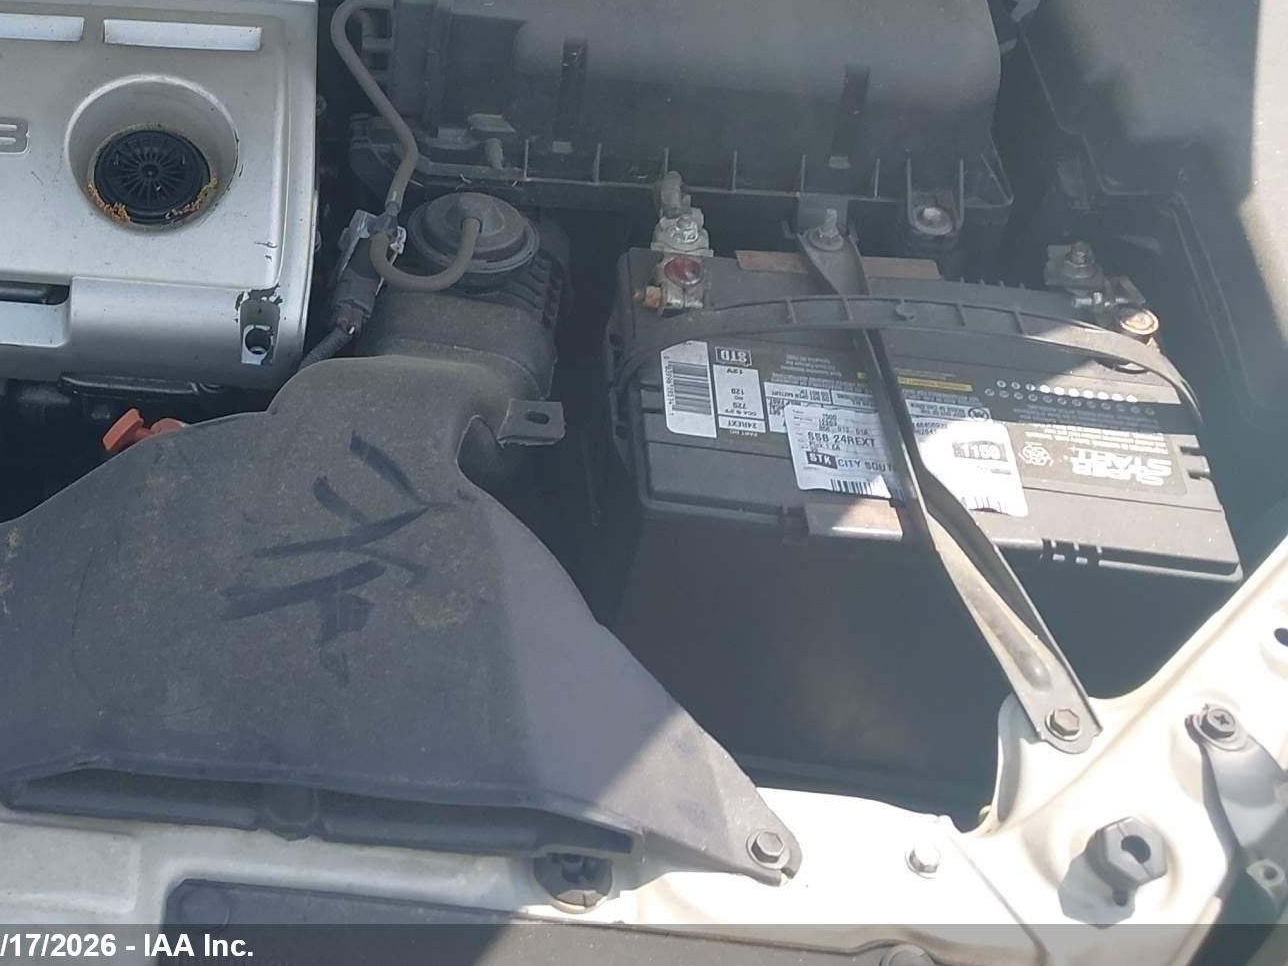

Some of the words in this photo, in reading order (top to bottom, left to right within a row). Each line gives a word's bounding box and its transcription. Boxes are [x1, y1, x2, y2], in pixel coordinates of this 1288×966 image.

[727, 419, 757, 430] 24REXT
[832, 434, 875, 448] 24REXT
[838, 459, 862, 468] CITY
